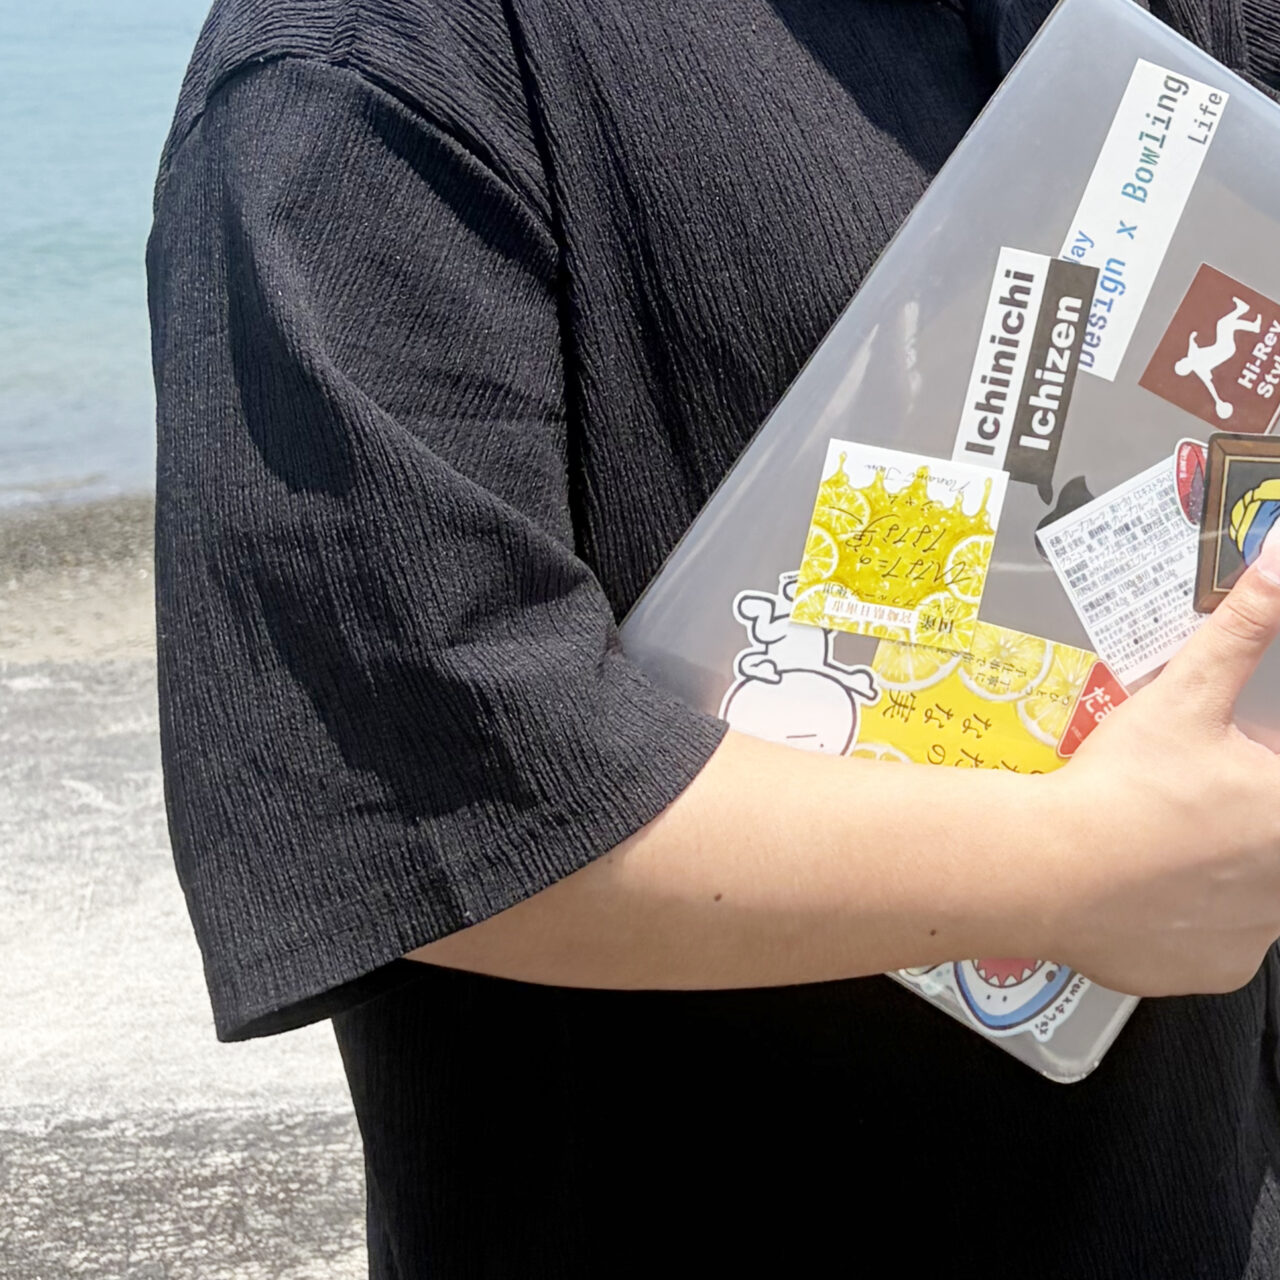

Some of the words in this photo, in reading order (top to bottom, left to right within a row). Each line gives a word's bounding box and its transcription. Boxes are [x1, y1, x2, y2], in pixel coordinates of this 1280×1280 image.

[1121, 75, 1189, 203] Bowling
[1188, 93, 1222, 145] Life
[1116, 220, 1138, 239] x
[965, 269, 1035, 456] Ichinichi
[1078, 257, 1126, 368] Design
[1019, 295, 1083, 450] Ichizen
[882, 688, 993, 739] なな実
